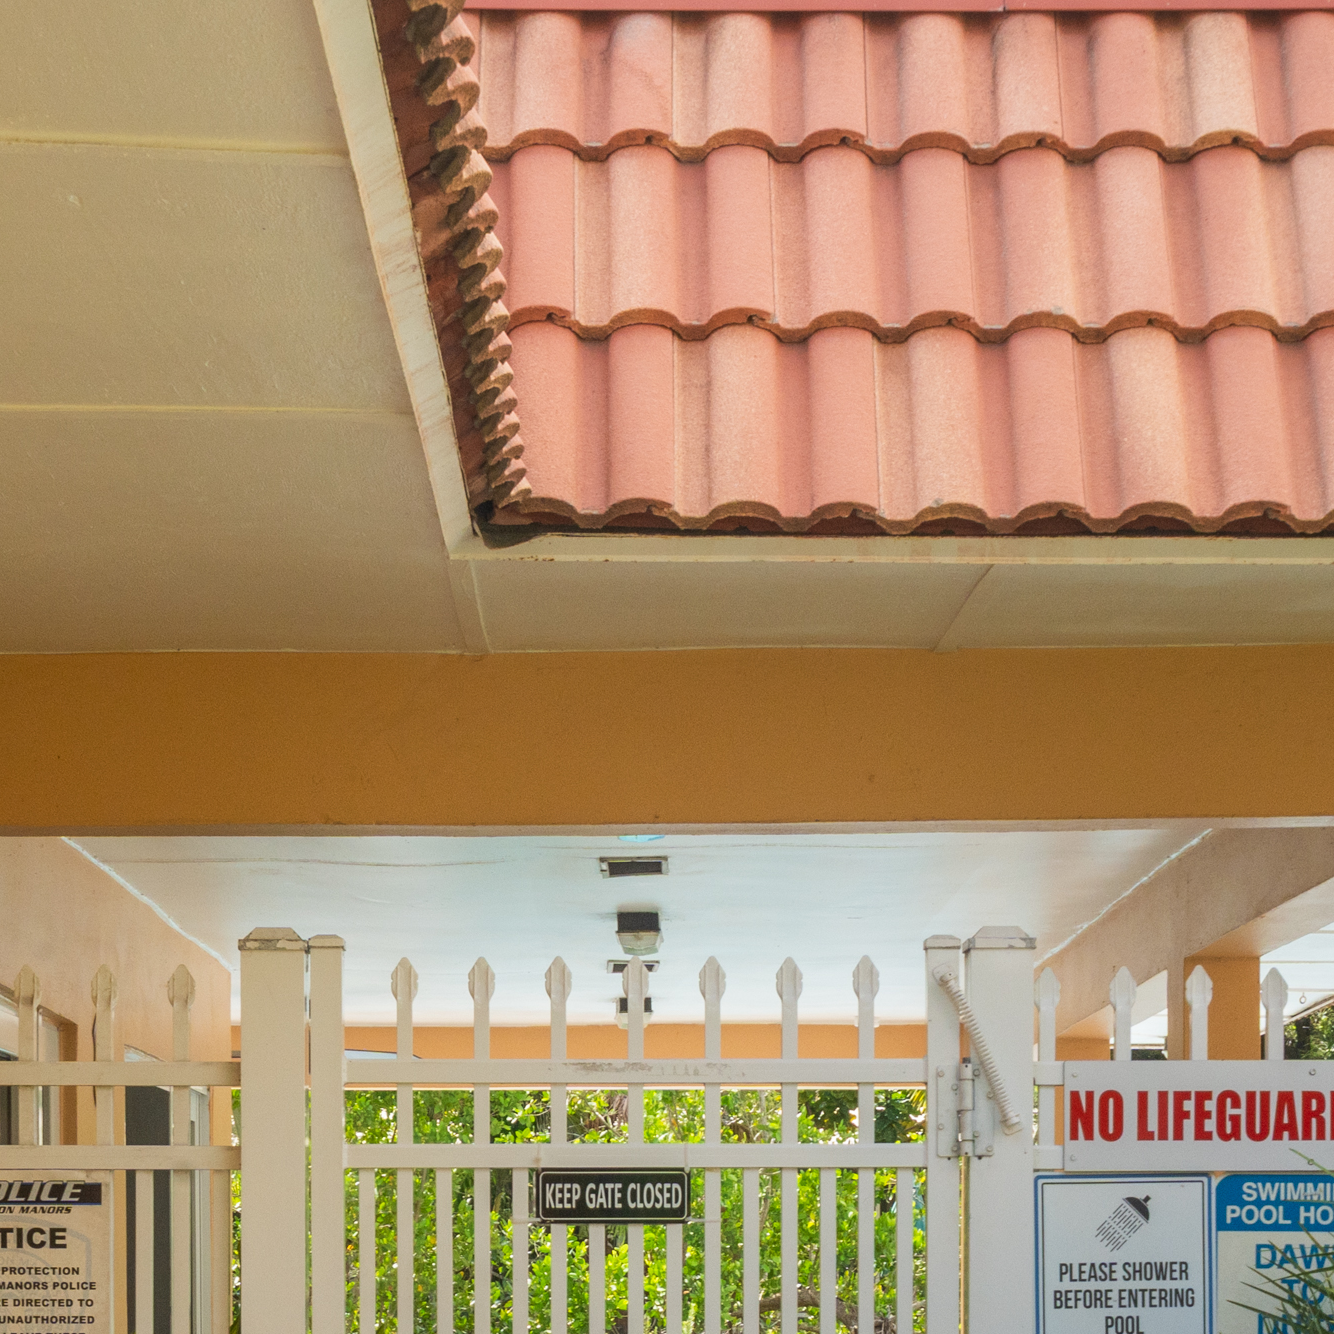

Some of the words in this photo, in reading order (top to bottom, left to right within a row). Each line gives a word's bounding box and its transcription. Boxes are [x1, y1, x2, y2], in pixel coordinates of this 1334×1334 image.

[1069, 1089, 1124, 1142] NO
[545, 1182, 581, 1209] KEEP
[585, 1182, 623, 1209] GATE
[627, 1182, 683, 1209] CLOSED
[18, 1206, 73, 1214] MANORS
[1225, 1204, 1292, 1225] POOL
[1, 1266, 80, 1276] PROTECTION
[1059, 1262, 1118, 1283] PLEASE
[1122, 1261, 1189, 1282] SHOWER
[52, 1281, 97, 1291] POLICE
[13, 1298, 74, 1308] DIRECTED
[77, 1298, 94, 1308] TO
[1053, 1289, 1113, 1310] BEFORE
[1118, 1287, 1195, 1309] ENTERING
